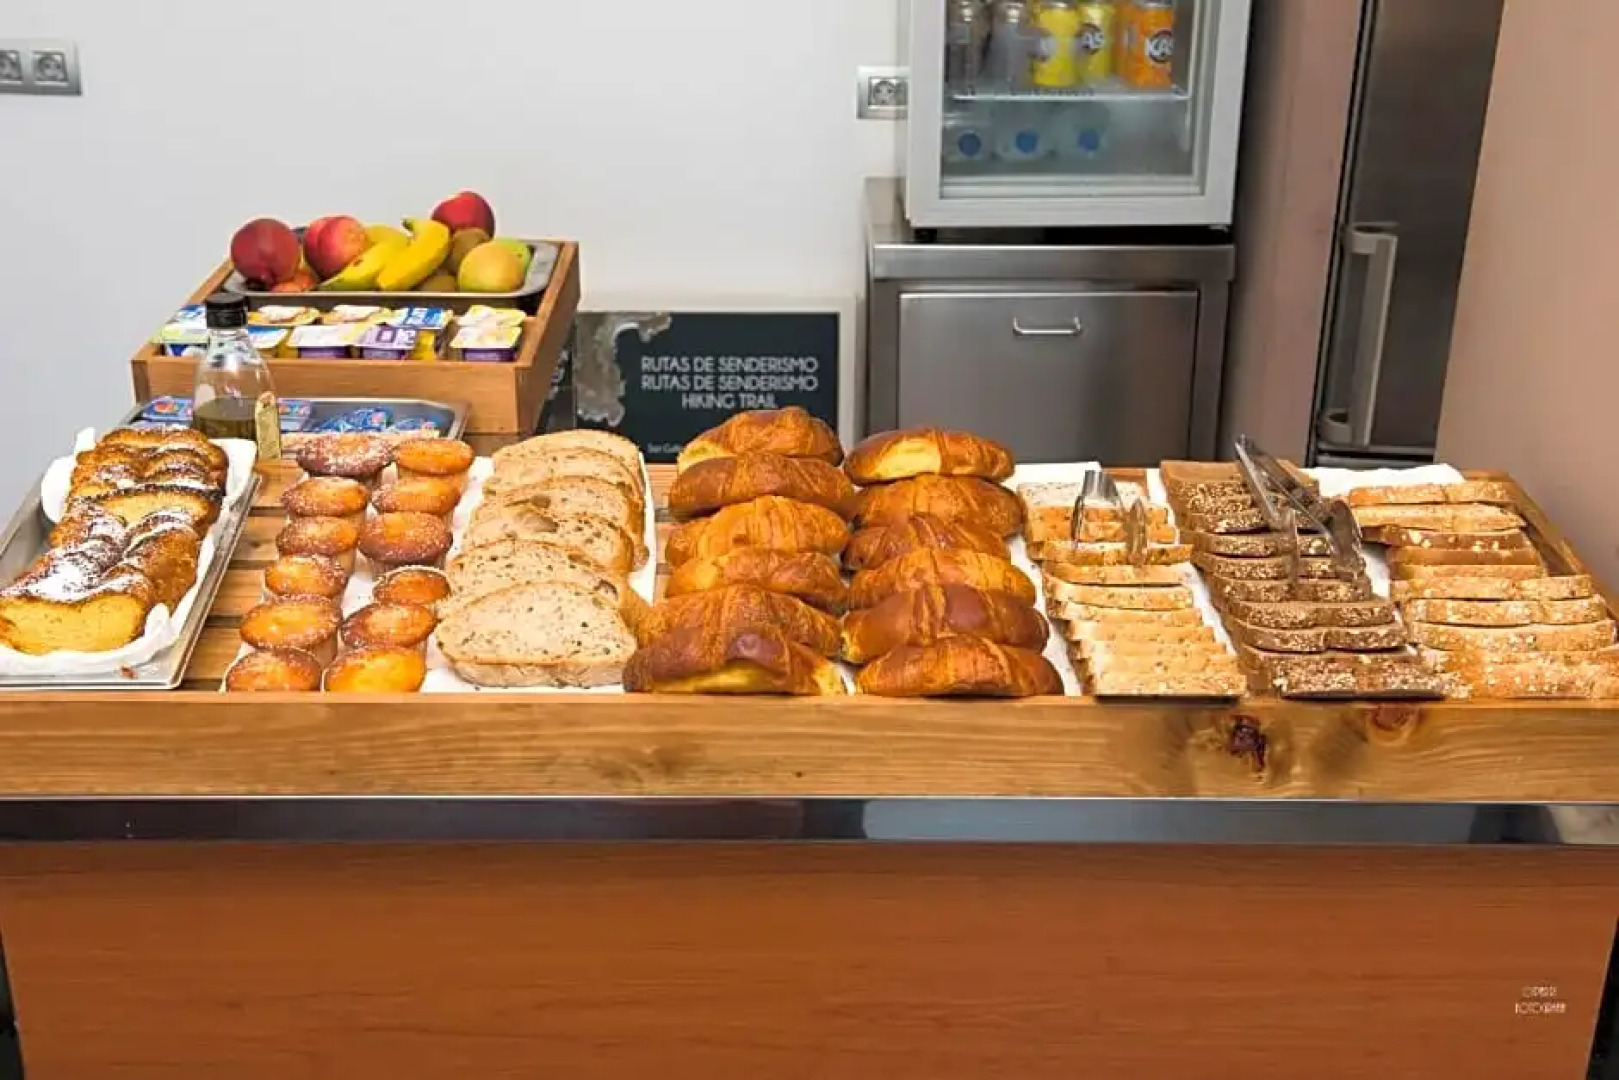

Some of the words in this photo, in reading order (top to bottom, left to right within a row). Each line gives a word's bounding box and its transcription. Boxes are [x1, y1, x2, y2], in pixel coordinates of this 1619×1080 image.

[641, 356, 690, 373] RUTAS
[693, 356, 716, 373] DE
[717, 356, 819, 373] SENDERISMO
[641, 374, 690, 391] RUTAS
[693, 374, 716, 391] DE
[717, 374, 819, 391] SENDERISMO
[681, 392, 735, 409] HIKING
[738, 392, 777, 409] TRAIL
